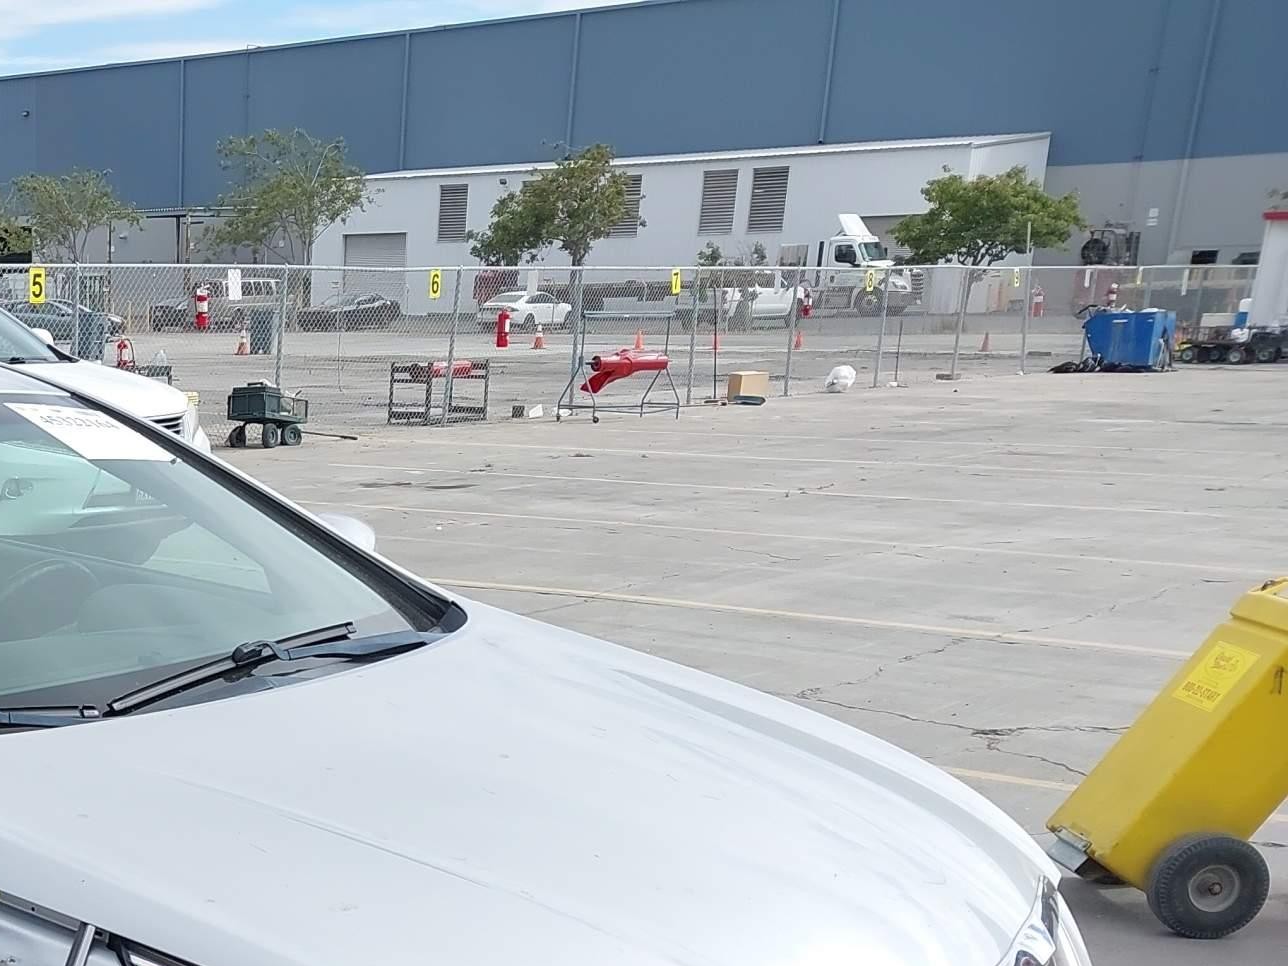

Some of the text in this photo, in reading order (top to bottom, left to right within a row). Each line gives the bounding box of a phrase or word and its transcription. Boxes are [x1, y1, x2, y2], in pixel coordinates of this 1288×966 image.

[32, 273, 43, 299] 5
[431, 273, 440, 295] 6
[673, 272, 679, 290] 7
[867, 272, 874, 289] 8
